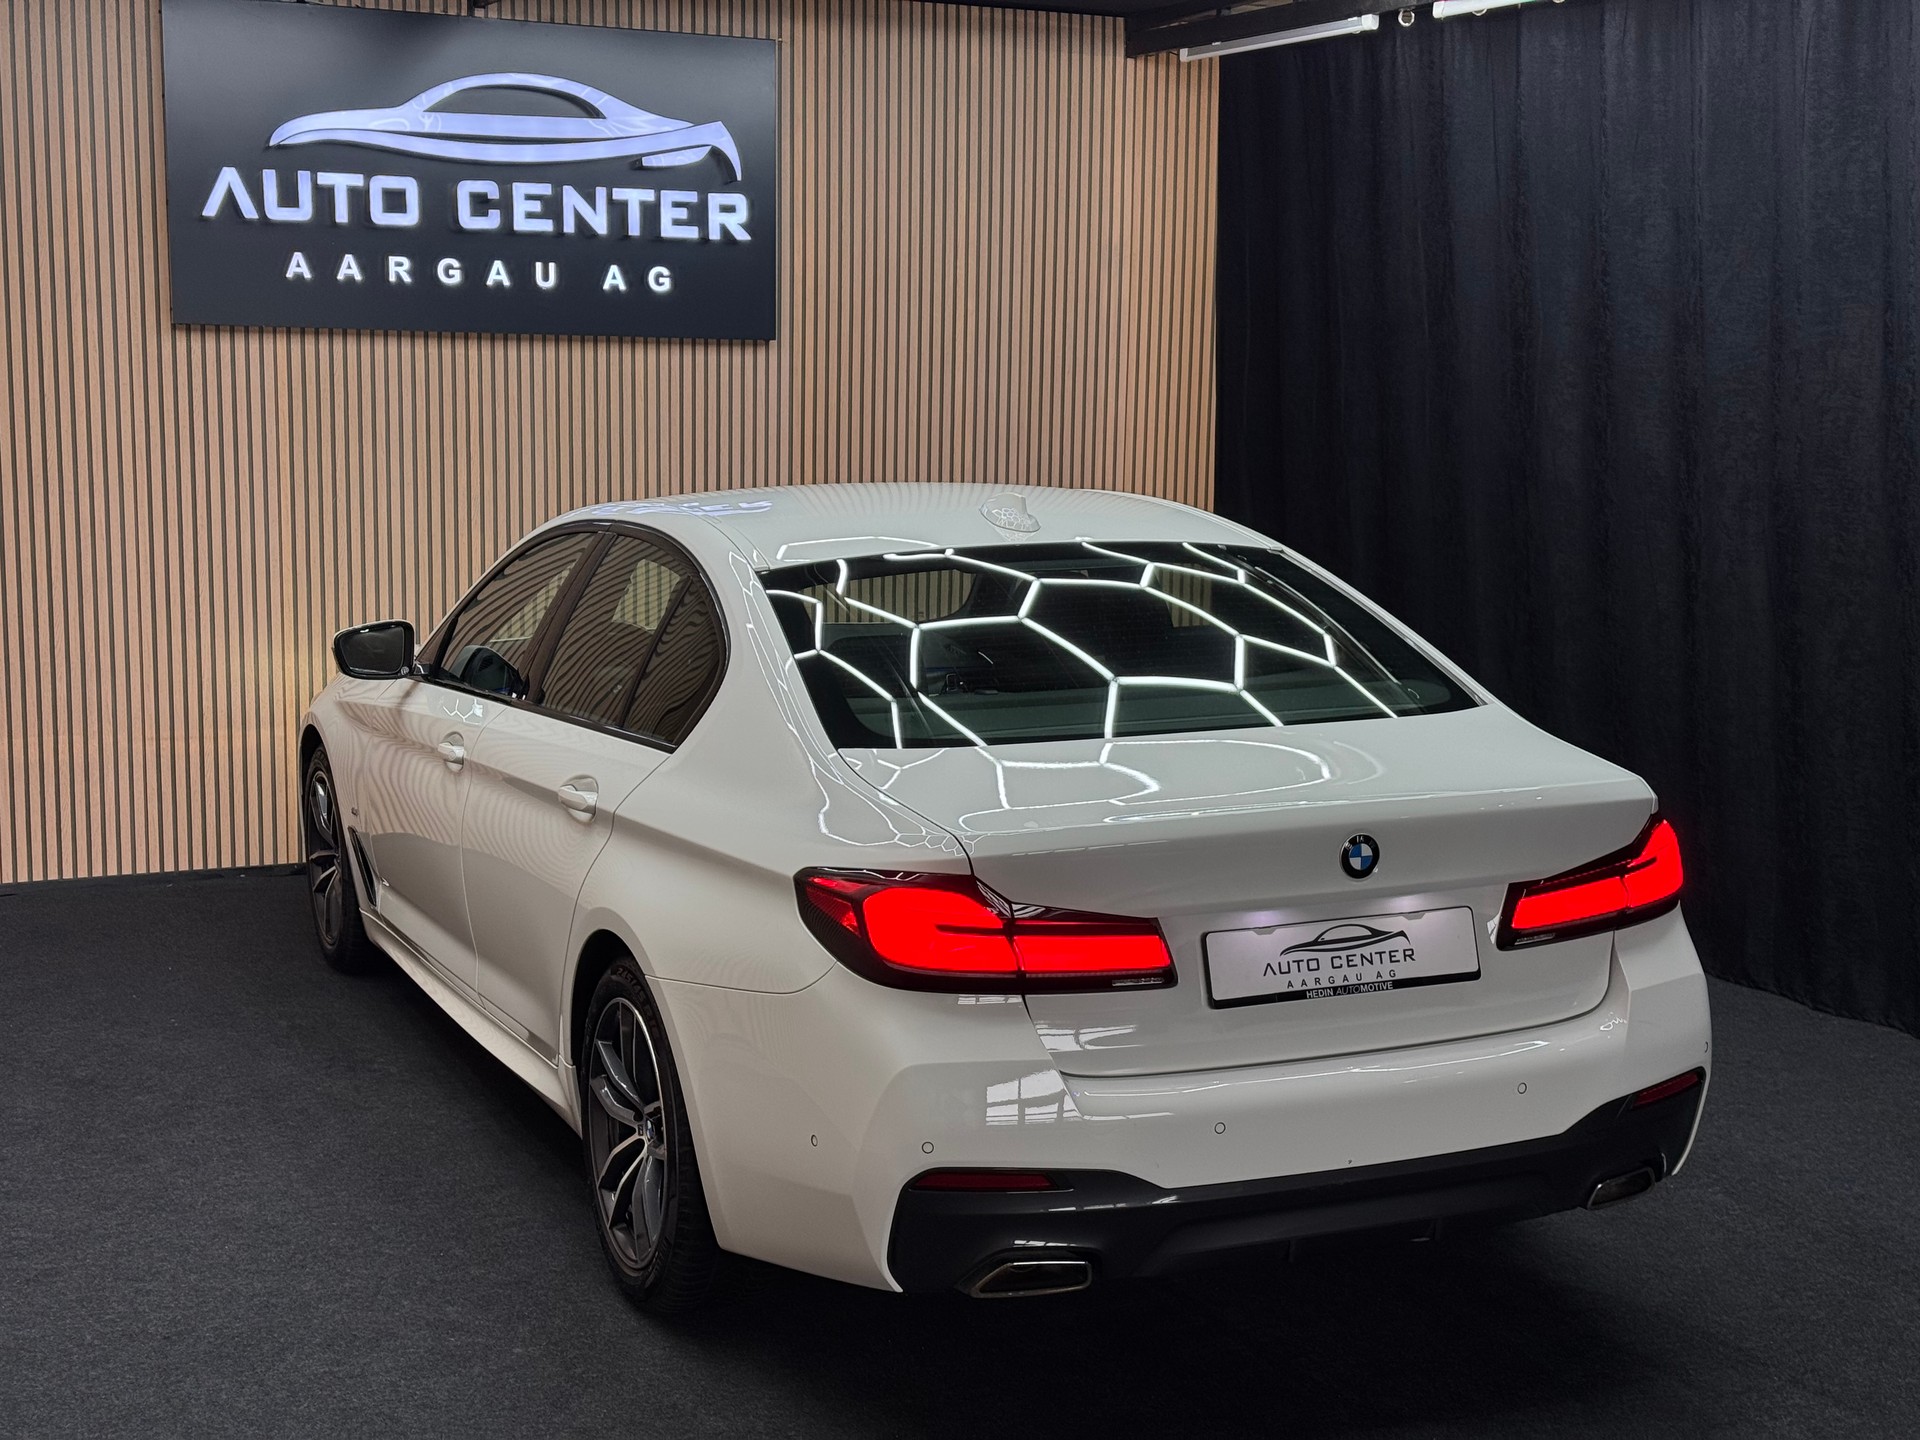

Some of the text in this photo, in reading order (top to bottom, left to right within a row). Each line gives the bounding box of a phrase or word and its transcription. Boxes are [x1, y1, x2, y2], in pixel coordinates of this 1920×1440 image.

[202, 166, 752, 241] AUTO CENTER
[286, 252, 673, 292] AARGAU AG
[1263, 948, 1416, 977] AUTO CENTER
[1287, 969, 1396, 989] AARGAU AG
[1306, 981, 1393, 999] HEDIN AUTOMOTIVE
